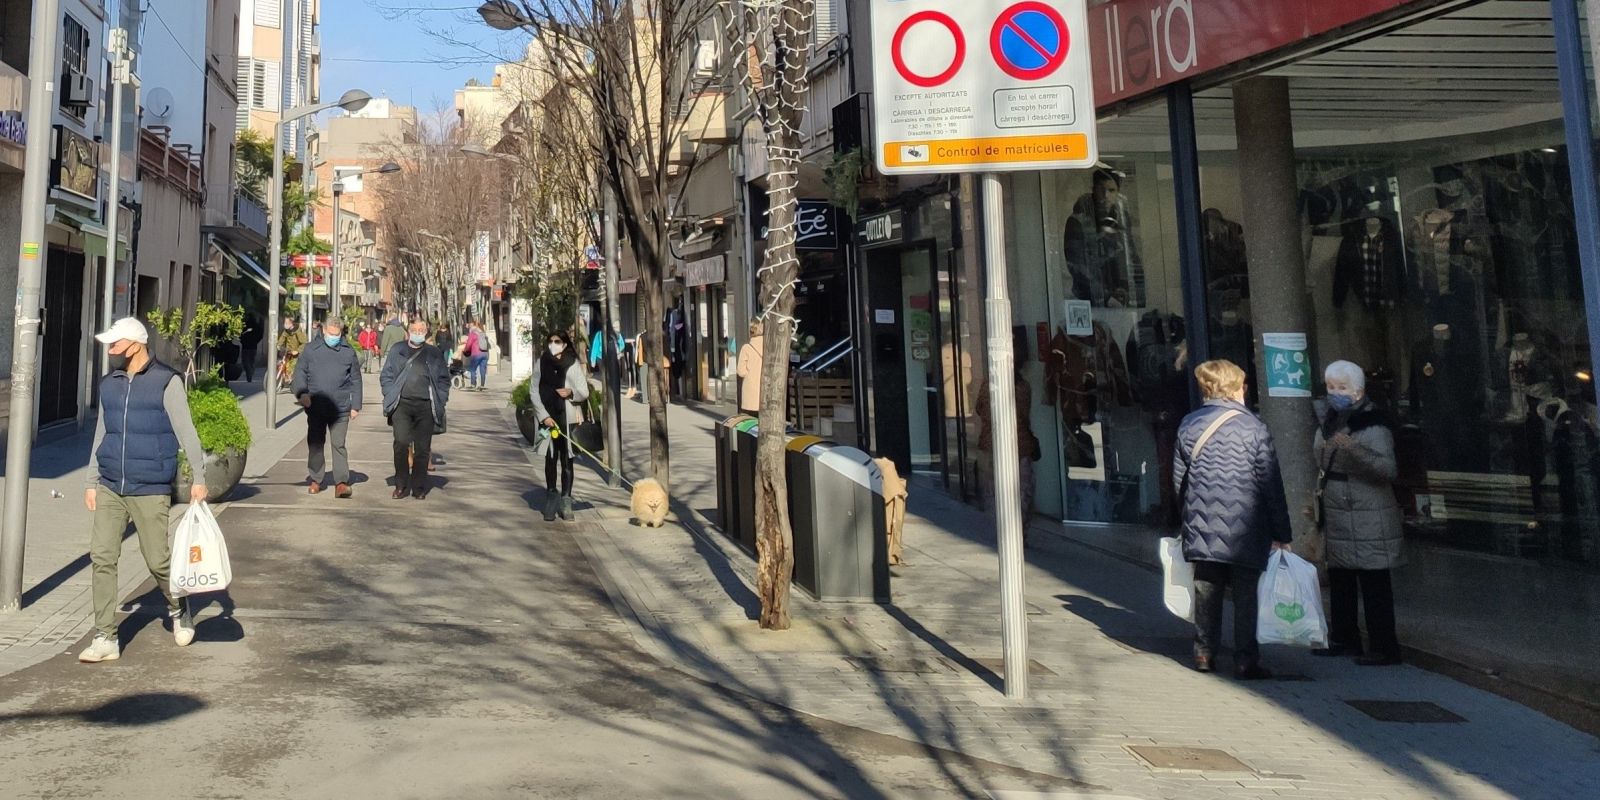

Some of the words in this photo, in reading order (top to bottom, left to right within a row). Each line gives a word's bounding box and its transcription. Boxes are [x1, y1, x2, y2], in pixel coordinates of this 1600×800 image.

[1105, 0, 1198, 94] llera
[894, 93, 922, 101] EXCEPTE
[924, 90, 968, 99] AUTORITZATS
[937, 146, 980, 158] Control
[985, 145, 1000, 156] de
